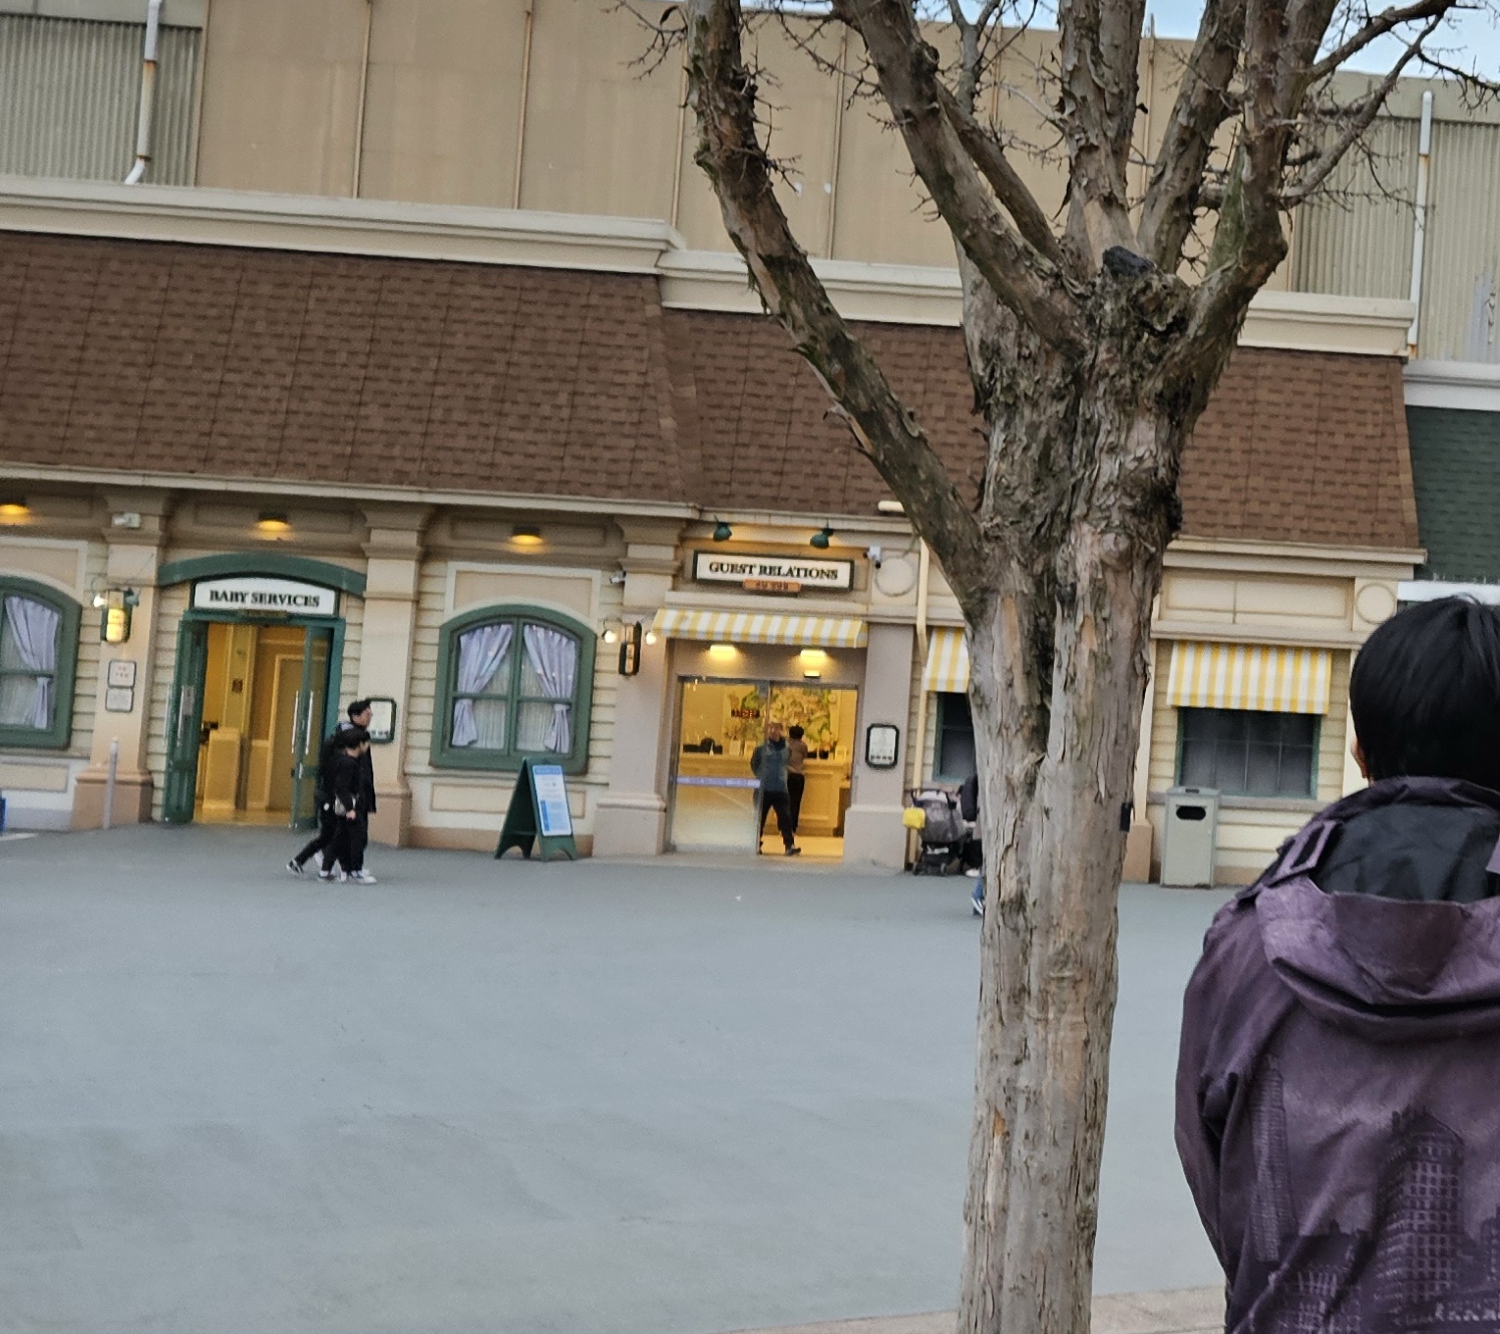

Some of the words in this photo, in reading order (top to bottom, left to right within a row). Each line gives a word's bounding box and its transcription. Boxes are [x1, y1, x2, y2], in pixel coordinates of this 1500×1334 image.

[709, 561, 756, 574] GUEST
[758, 564, 838, 580] RELATIONS
[209, 589, 248, 604] BABY
[250, 592, 320, 608] SERVICES
